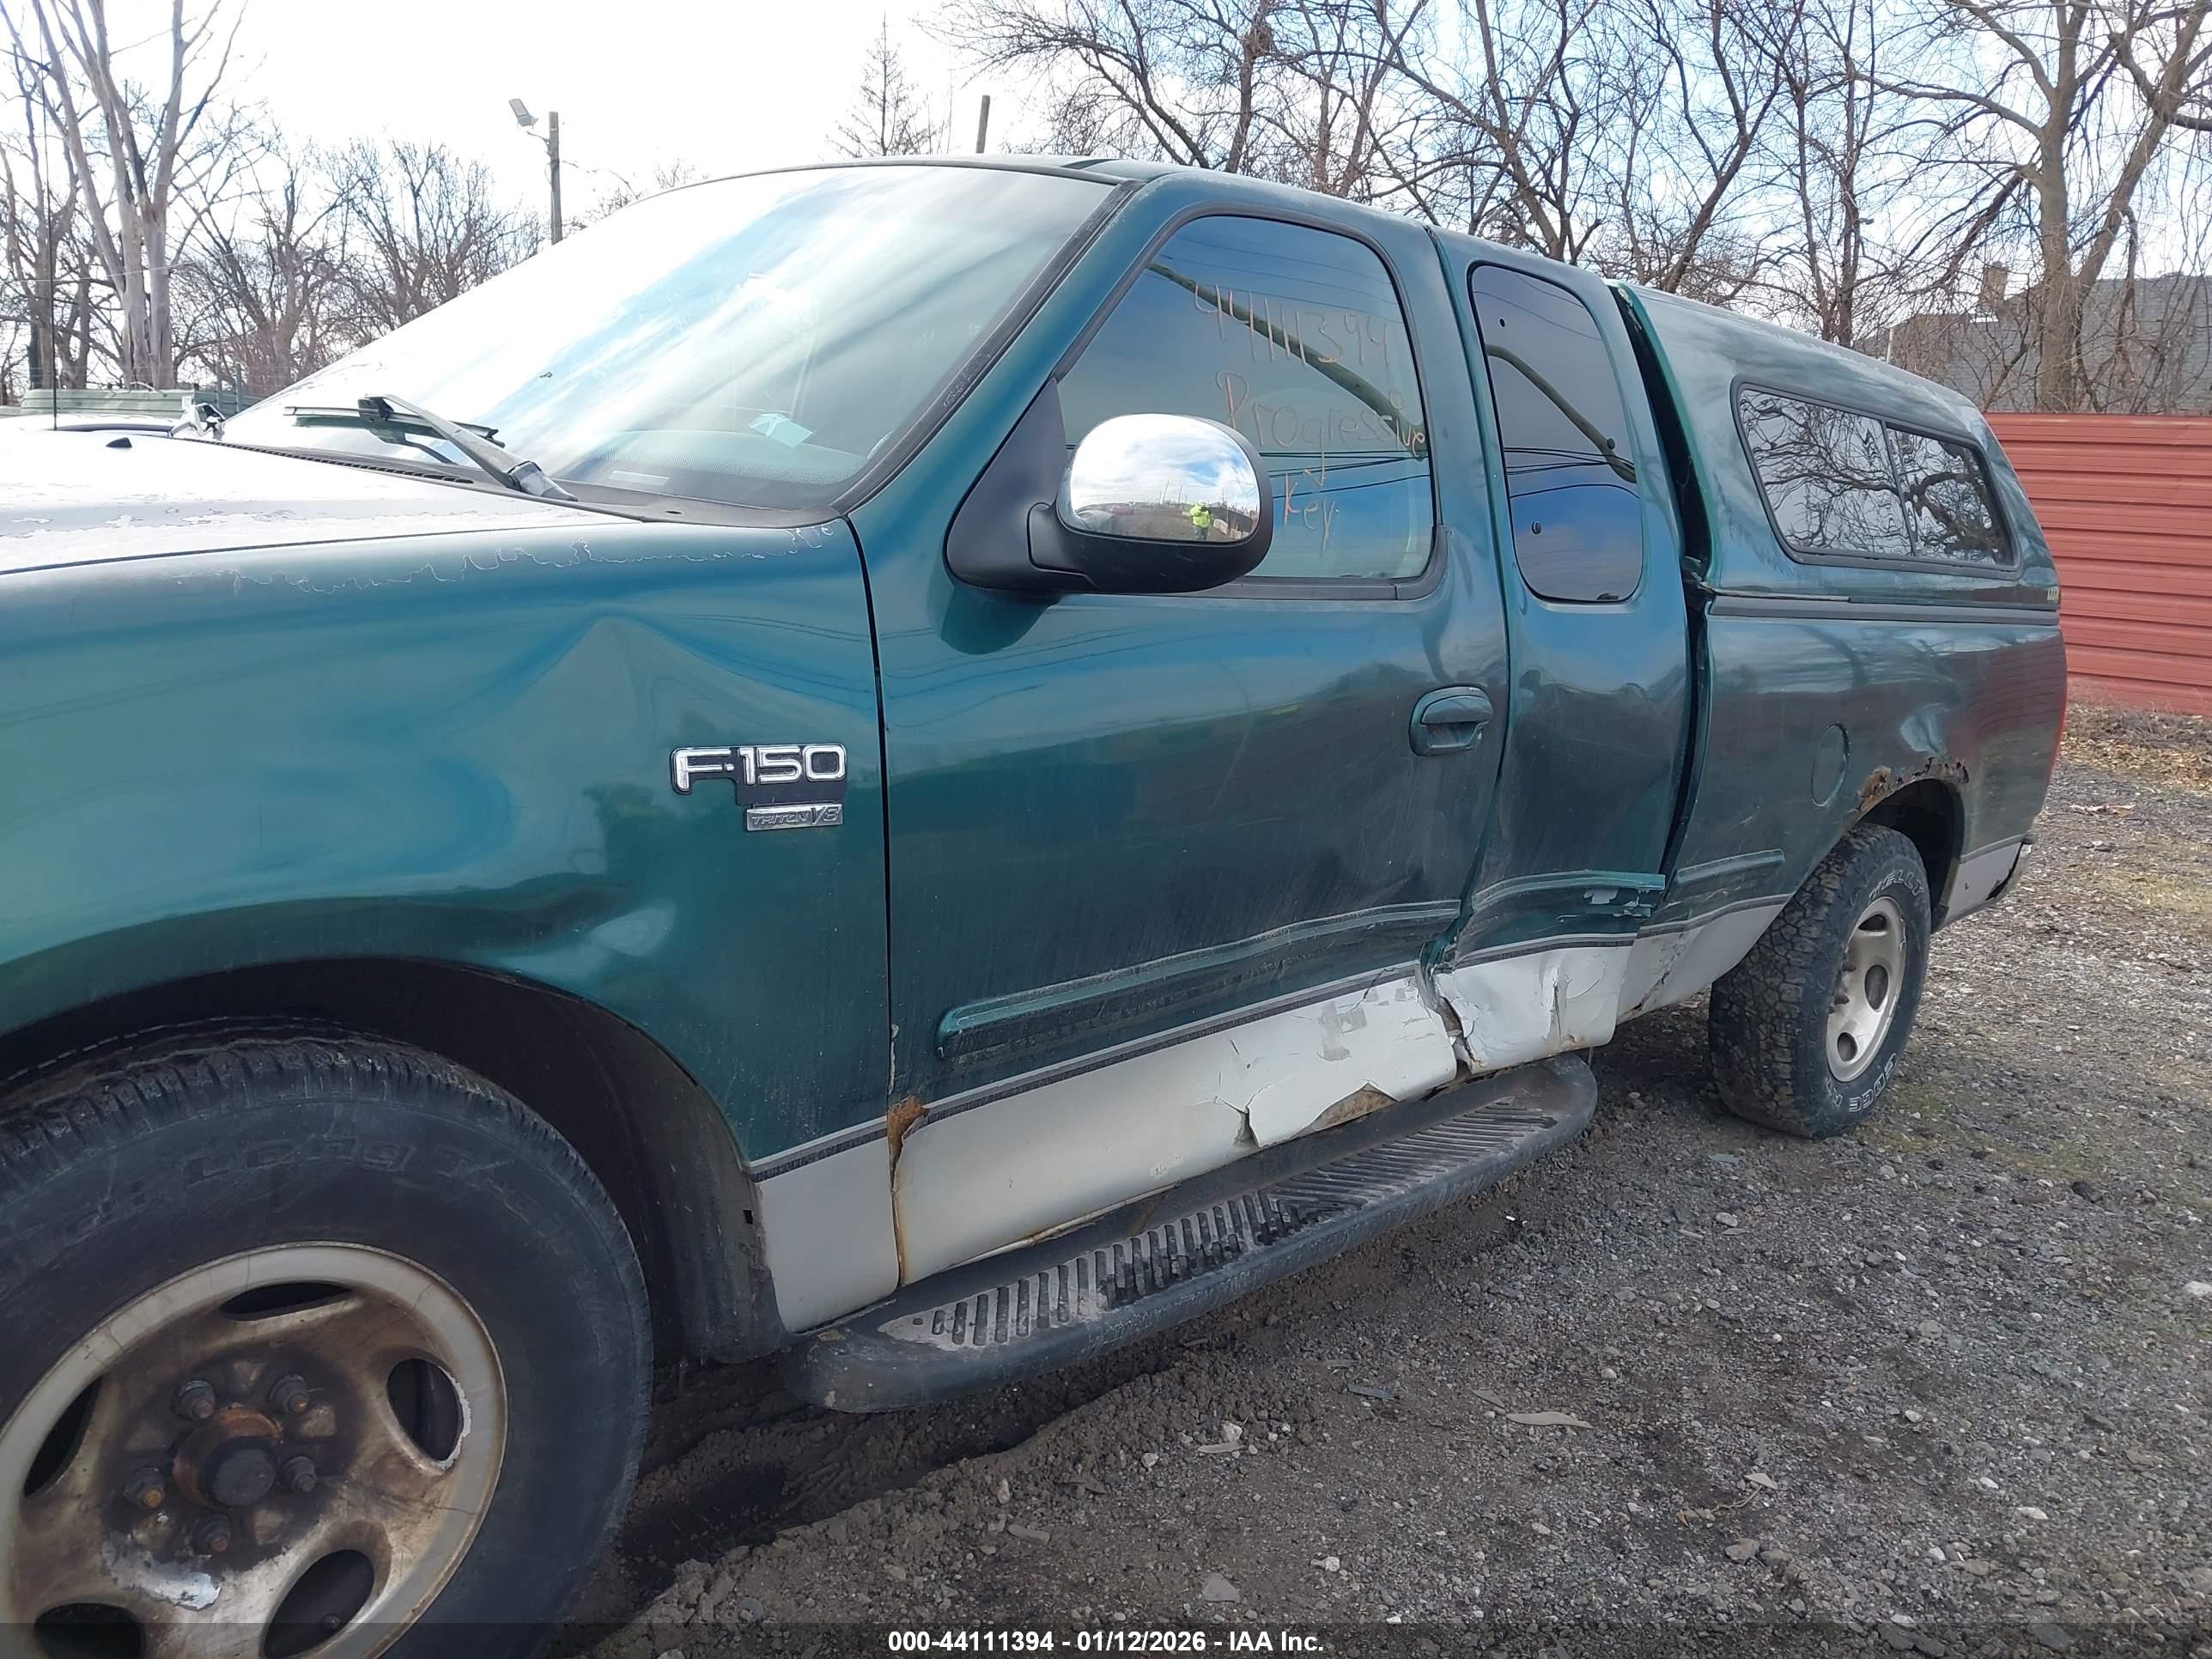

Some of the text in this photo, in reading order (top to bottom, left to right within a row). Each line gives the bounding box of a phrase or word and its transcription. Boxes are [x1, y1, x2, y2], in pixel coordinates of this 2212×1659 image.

[675, 744, 845, 791] F-150
[751, 806, 842, 825] TRITON V8
